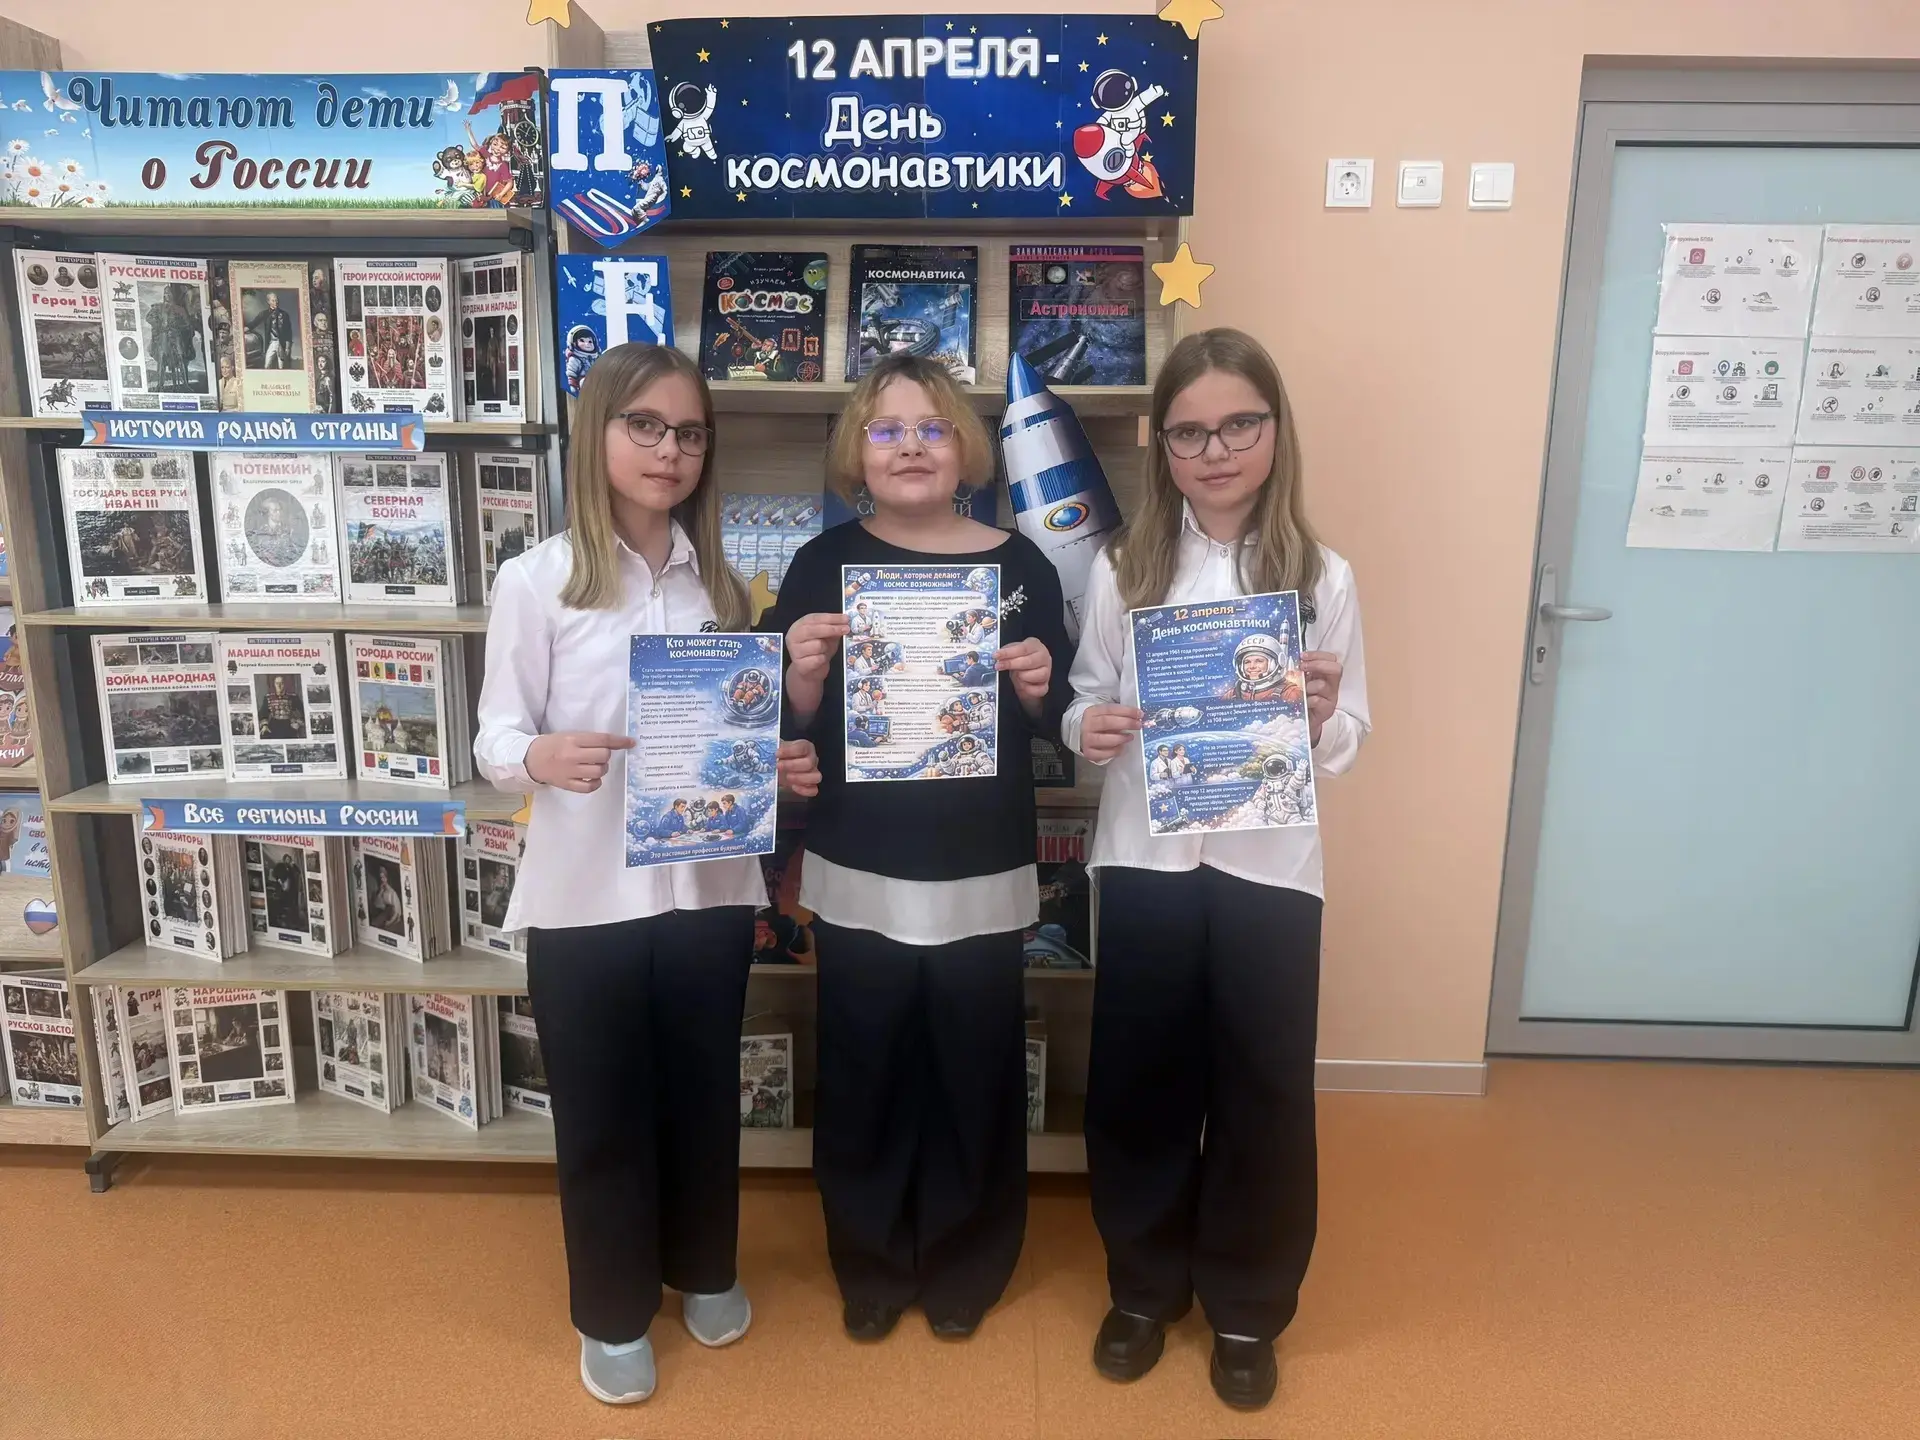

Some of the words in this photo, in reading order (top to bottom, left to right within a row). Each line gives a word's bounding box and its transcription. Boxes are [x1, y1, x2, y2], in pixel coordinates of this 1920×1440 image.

[789, 40, 836, 79] 12
[850, 37, 1059, 79] АПРЕЛЯ-
[68, 77, 295, 129] Читают
[316, 83, 434, 129] дети
[550, 78, 633, 171] П
[824, 97, 942, 147] День
[142, 157, 167, 190] о
[190, 140, 373, 190] России
[727, 155, 1063, 190] космонавтики
[1016, 246, 1084, 256] ЗАНИМАТЕЛЬНЫЙ
[136, 259, 167, 267] ИСТОРИЯ
[168, 260, 196, 268] РОССИИ
[109, 266, 166, 278] РУССКИЕ
[343, 272, 366, 281] ГЕРОИ
[367, 271, 404, 281] РУССКОЙ
[405, 272, 441, 281] ИСТОРИИ
[868, 270, 965, 279] КОСМОНАВТИКА
[750, 278, 786, 286] ИЗУЧАЕМ
[32, 293, 76, 307] Герои
[81, 295, 100, 307] 18
[462, 304, 483, 314] ОРДЕНА
[485, 303, 490, 312] И
[491, 301, 517, 312] НАГРАДЫ
[1030, 300, 1128, 318] Астрономия
[110, 419, 204, 440] ИСТОРИЯ
[217, 417, 297, 444] РОДНОЙ
[310, 421, 398, 441] СТРАНЫ
[233, 463, 312, 476] ПОТЕМКИН
[73, 488, 129, 498] ГОСУДАРЬ
[131, 488, 156, 498] ВСЕЯ
[160, 488, 187, 498] РУСИ
[105, 500, 143, 509] ИВАН
[146, 500, 159, 509] III
[364, 496, 424, 507] СЕВЕРНАЯ
[483, 496, 509, 508] РУССКИЕ
[510, 498, 533, 510] СВЯТЫЕ
[372, 506, 417, 518] ВОЙНА
[876, 569, 902, 580] Люди,
[903, 572, 933, 580] которые
[933, 572, 961, 580] делают
[1173, 608, 1189, 621] 12
[1191, 605, 1234, 618] апреля
[1151, 626, 1181, 643] День
[1183, 618, 1270, 634] космонавтики
[666, 637, 684, 649] Кто
[686, 638, 716, 647] может
[719, 639, 743, 649] стать
[228, 649, 274, 658] МАРШАЛ
[277, 648, 320, 659] ПОБЕДЫ
[356, 647, 393, 660] ГОРОДА
[396, 650, 434, 662] РОССИИ
[669, 649, 739, 659] космонавтом?
[106, 673, 148, 686] ВОЙНА
[152, 672, 216, 684] НАРОДНАЯ
[184, 803, 225, 824] Все
[237, 808, 327, 825] регионы
[340, 805, 419, 825] России
[476, 824, 516, 841] РУССКИЙ
[361, 837, 399, 853] КОСТЮМ
[484, 838, 508, 852] ЯЗЫК
[193, 987, 254, 996] НАРОДН
[193, 993, 256, 1005] МЕДИЦИНА
[434, 992, 466, 1012] ДРЕВНИХ
[426, 1000, 454, 1019] СЛАВЯН
[8, 1020, 44, 1032] РУССКОЕ
[45, 1023, 75, 1035] ЗАСТО
